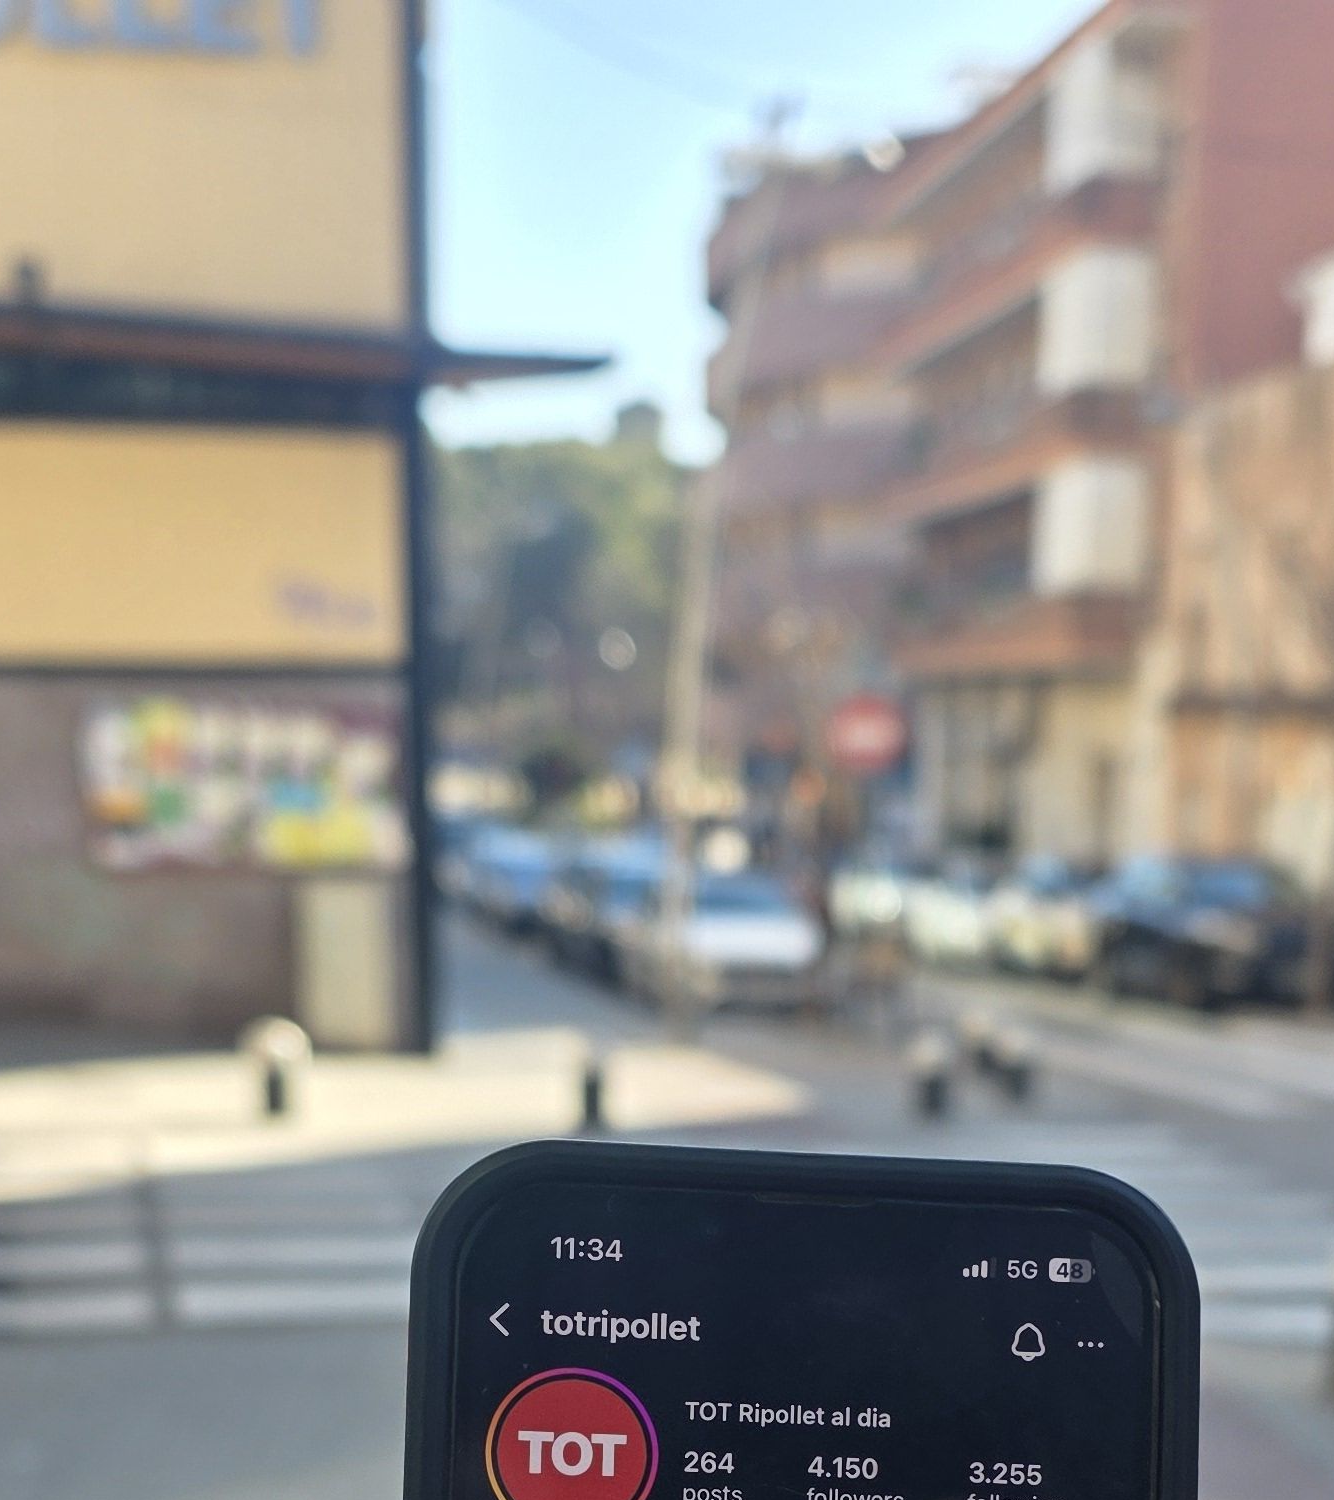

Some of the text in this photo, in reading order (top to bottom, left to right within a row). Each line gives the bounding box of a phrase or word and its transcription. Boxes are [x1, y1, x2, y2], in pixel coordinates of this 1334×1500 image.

[551, 1237, 622, 1261] 11:34
[1008, 1260, 1085, 1280] 5G 48
[541, 1309, 700, 1343] totripollet
[685, 1402, 890, 1427] TOT Ripollet al dia
[518, 1431, 628, 1477] TOT
[684, 1451, 1042, 1485] 264 4.150 3.255
